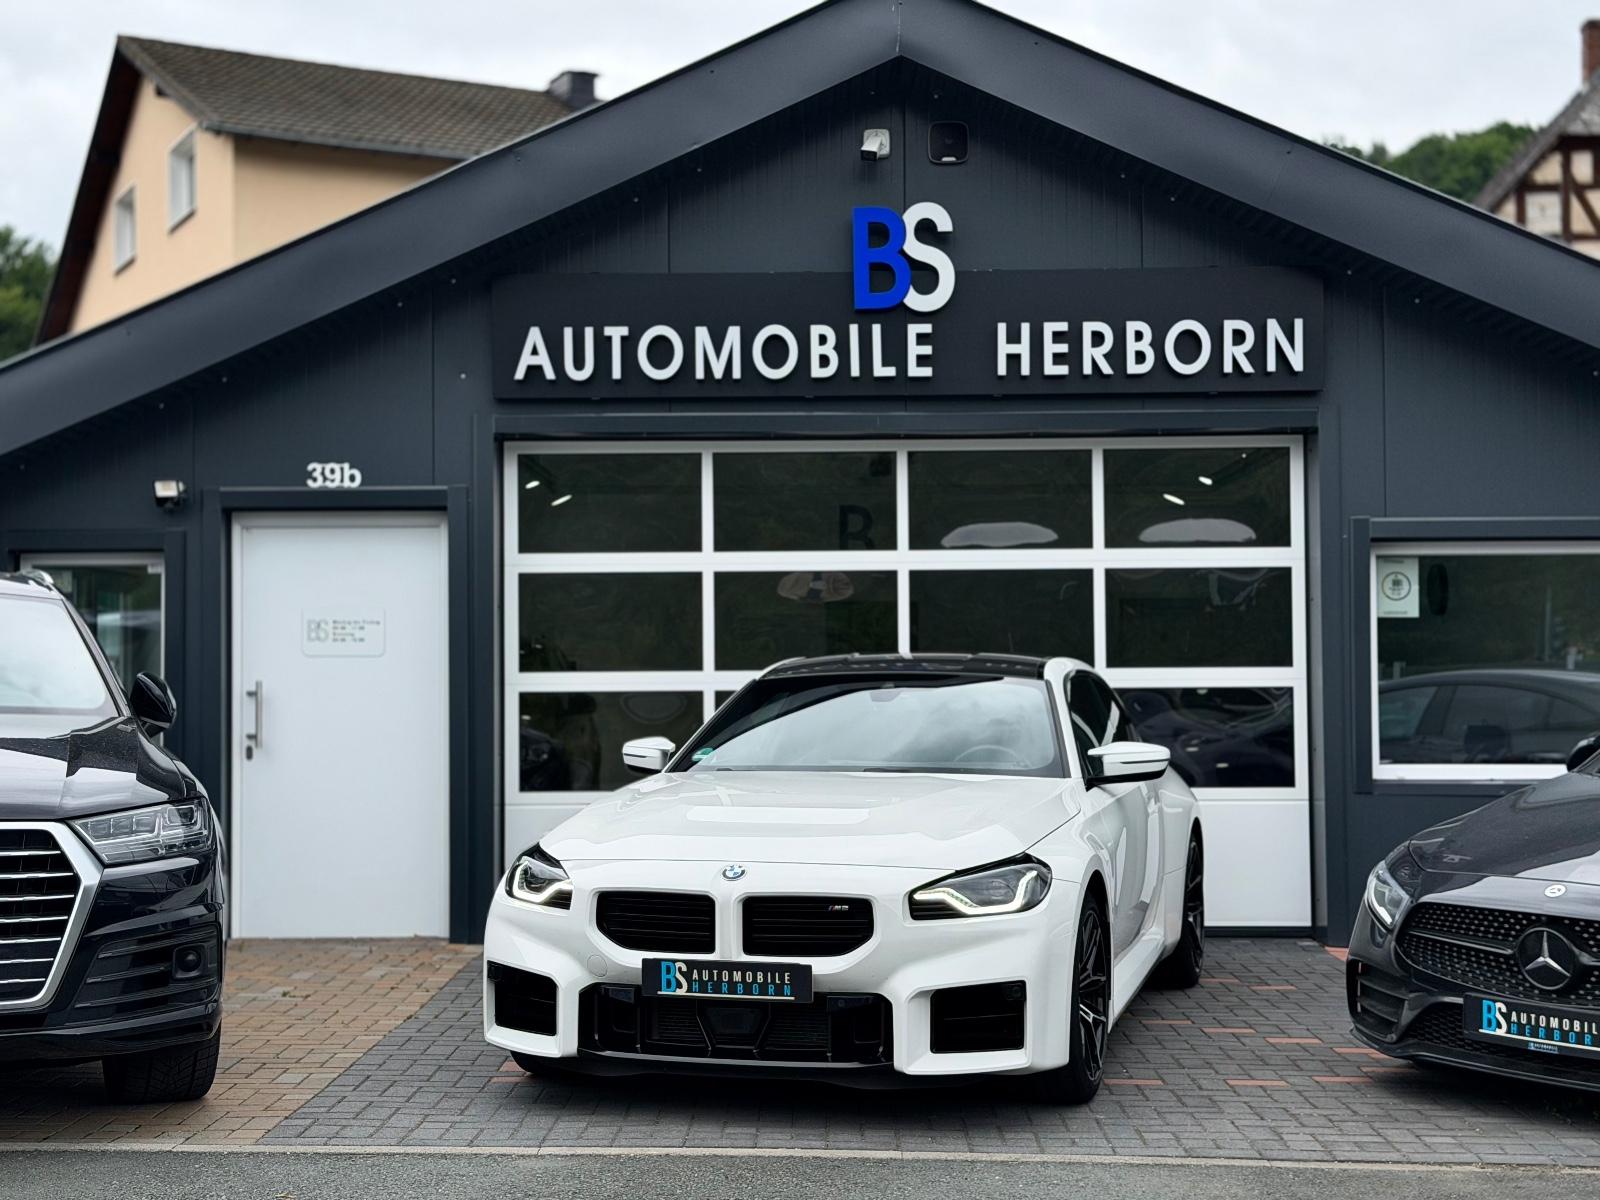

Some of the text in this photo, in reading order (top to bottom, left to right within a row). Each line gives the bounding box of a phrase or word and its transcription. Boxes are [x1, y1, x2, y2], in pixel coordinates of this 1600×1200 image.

[851, 201, 956, 312] BS
[513, 317, 1306, 382] AUTOMOBILE HERBORN
[306, 461, 363, 489] 39b
[660, 960, 689, 994] BS
[692, 968, 791, 984] AUTOMOBILE
[692, 981, 791, 996] HERBORN
[1482, 999, 1508, 1035] BS
[1510, 1010, 1599, 1035] AUTOMOBIL
